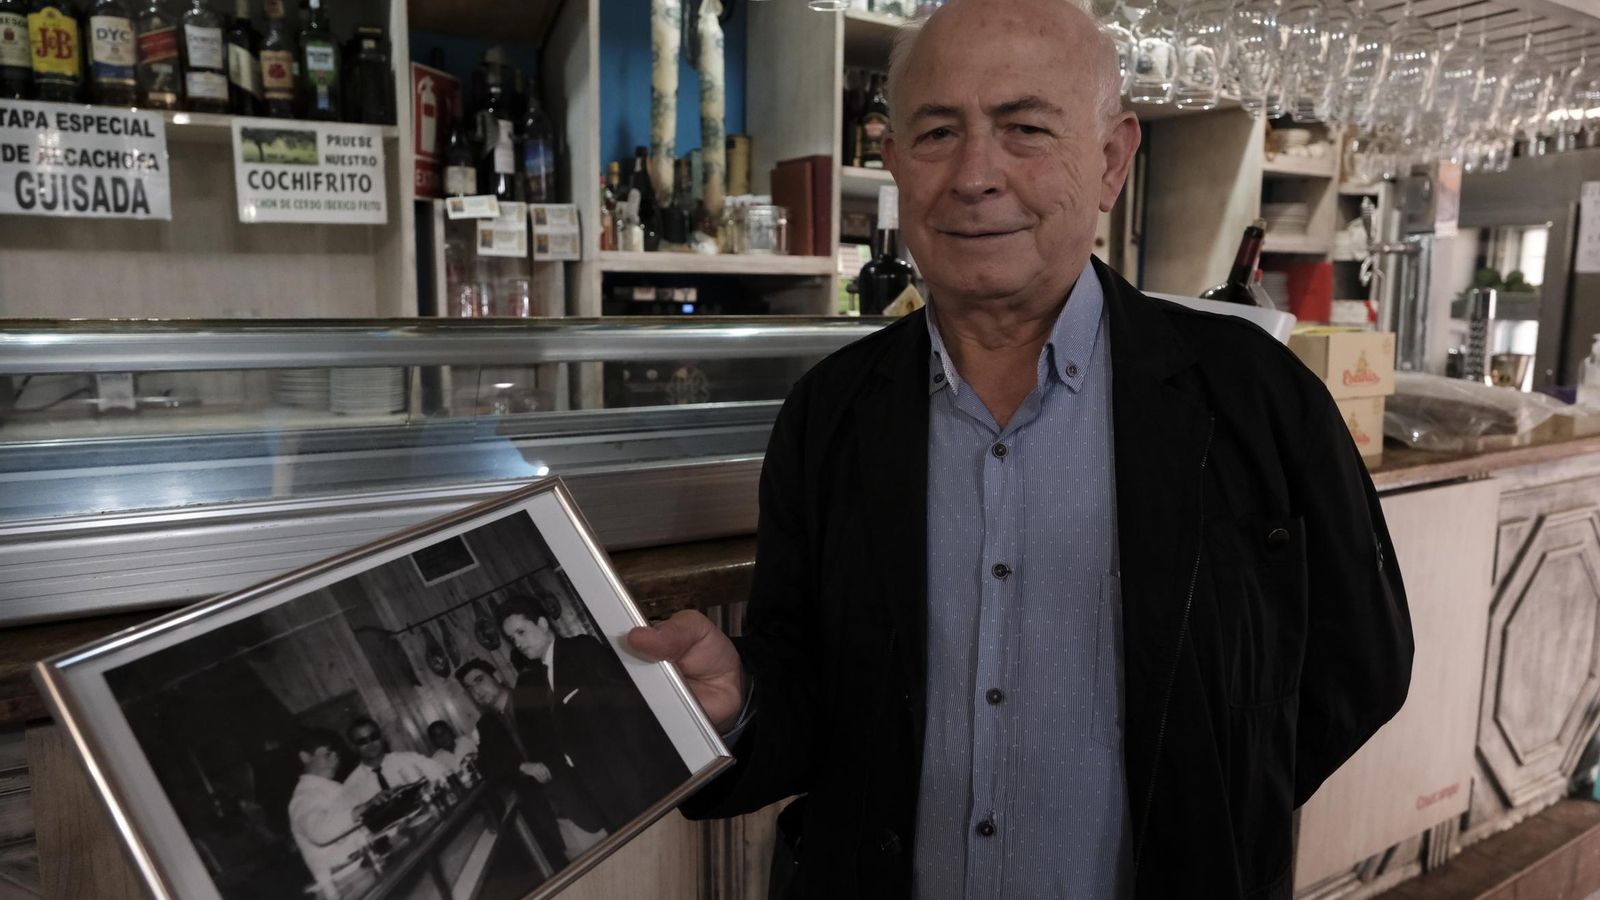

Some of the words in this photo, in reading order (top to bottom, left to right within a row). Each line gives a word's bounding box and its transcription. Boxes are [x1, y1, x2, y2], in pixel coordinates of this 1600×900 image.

[96, 28, 130, 42] DYC
[0, 108, 49, 129] TAPA
[56, 112, 156, 138] ESPECIAL
[326, 134, 373, 148] PRUEBE
[2, 144, 31, 164] DE
[325, 154, 378, 167] NUESTRO
[247, 169, 373, 193] COCHIFRITO
[14, 170, 152, 215] GUISADA
